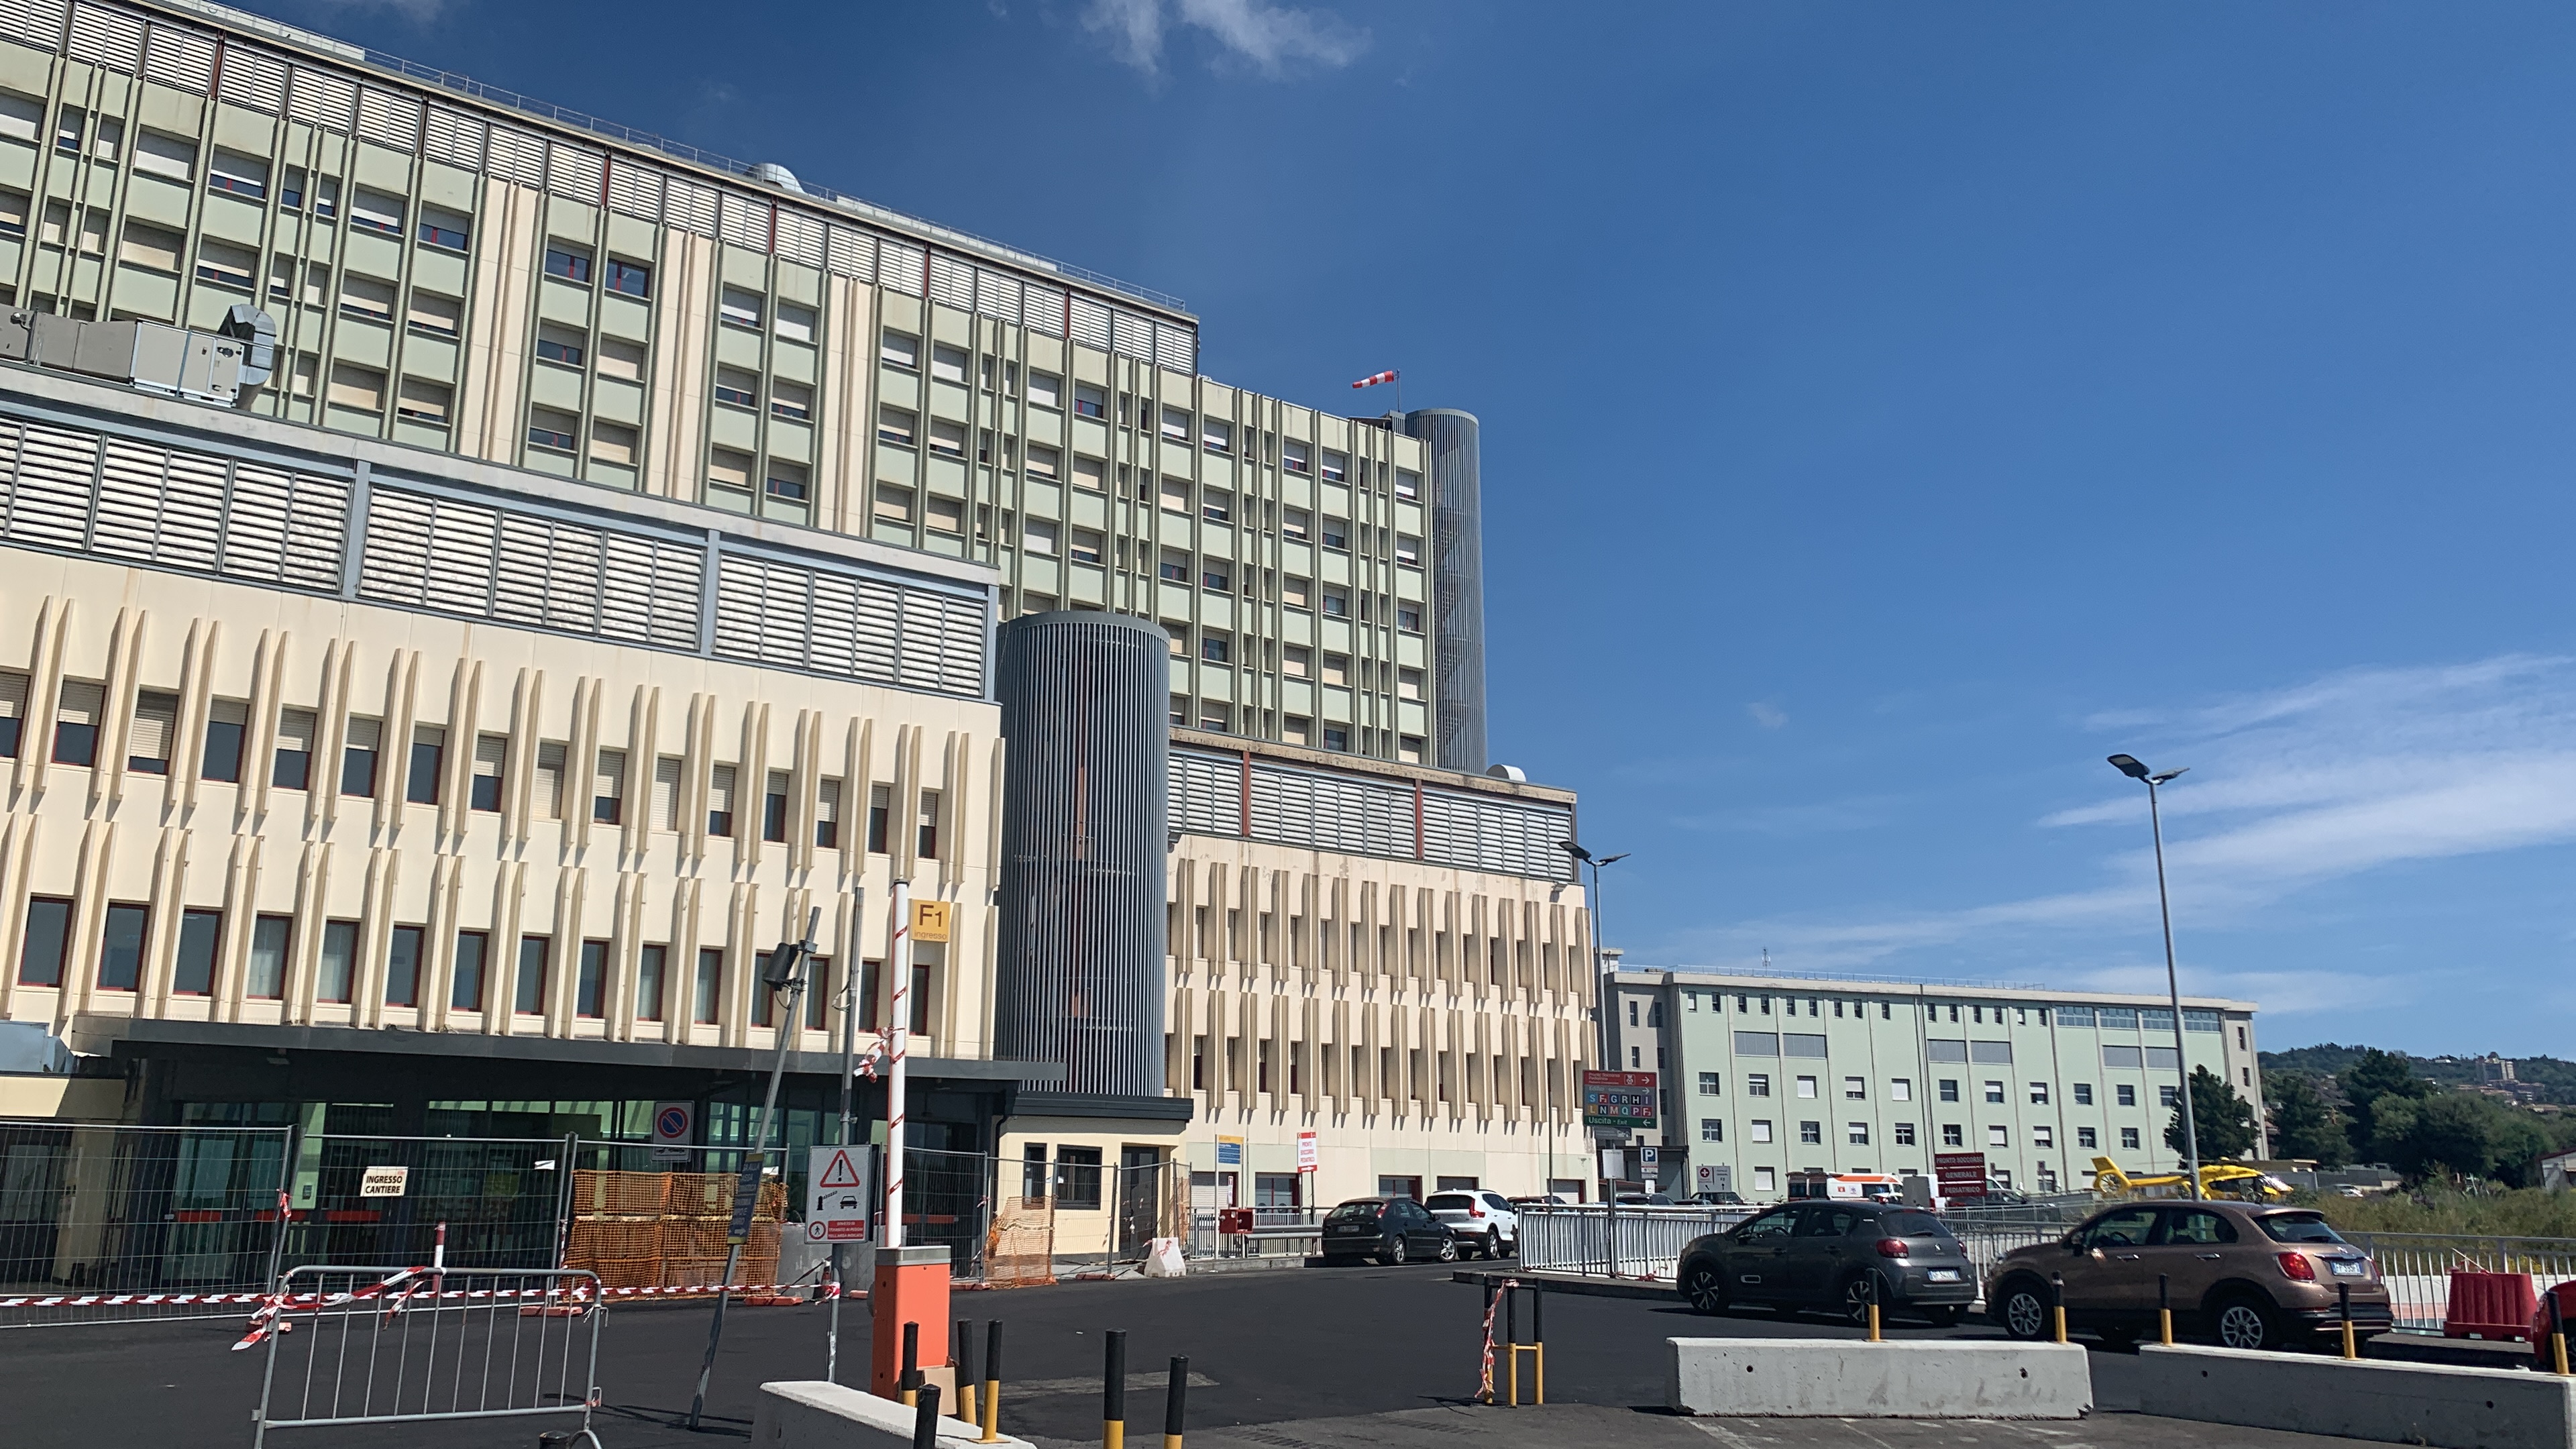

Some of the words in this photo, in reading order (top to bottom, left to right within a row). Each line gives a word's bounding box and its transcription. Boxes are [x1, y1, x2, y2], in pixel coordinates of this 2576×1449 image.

[920, 904, 942, 927] F1
[914, 930, 947, 940] ingresso
[1589, 1094, 1595, 1102] S
[1611, 1095, 1617, 1103] G
[1621, 1095, 1628, 1104] R
[1632, 1096, 1640, 1104] H
[1646, 1096, 1648, 1104] I
[1590, 1106, 1595, 1114] L
[1600, 1106, 1607, 1114] N
[1610, 1106, 1619, 1114] M
[1621, 1107, 1628, 1115] Q
[1589, 1116, 1611, 1124] Uscita
[1645, 1149, 1654, 1161] P
[366, 1175, 402, 1184] INGRESSO
[365, 1185, 400, 1193] CANTIERE
